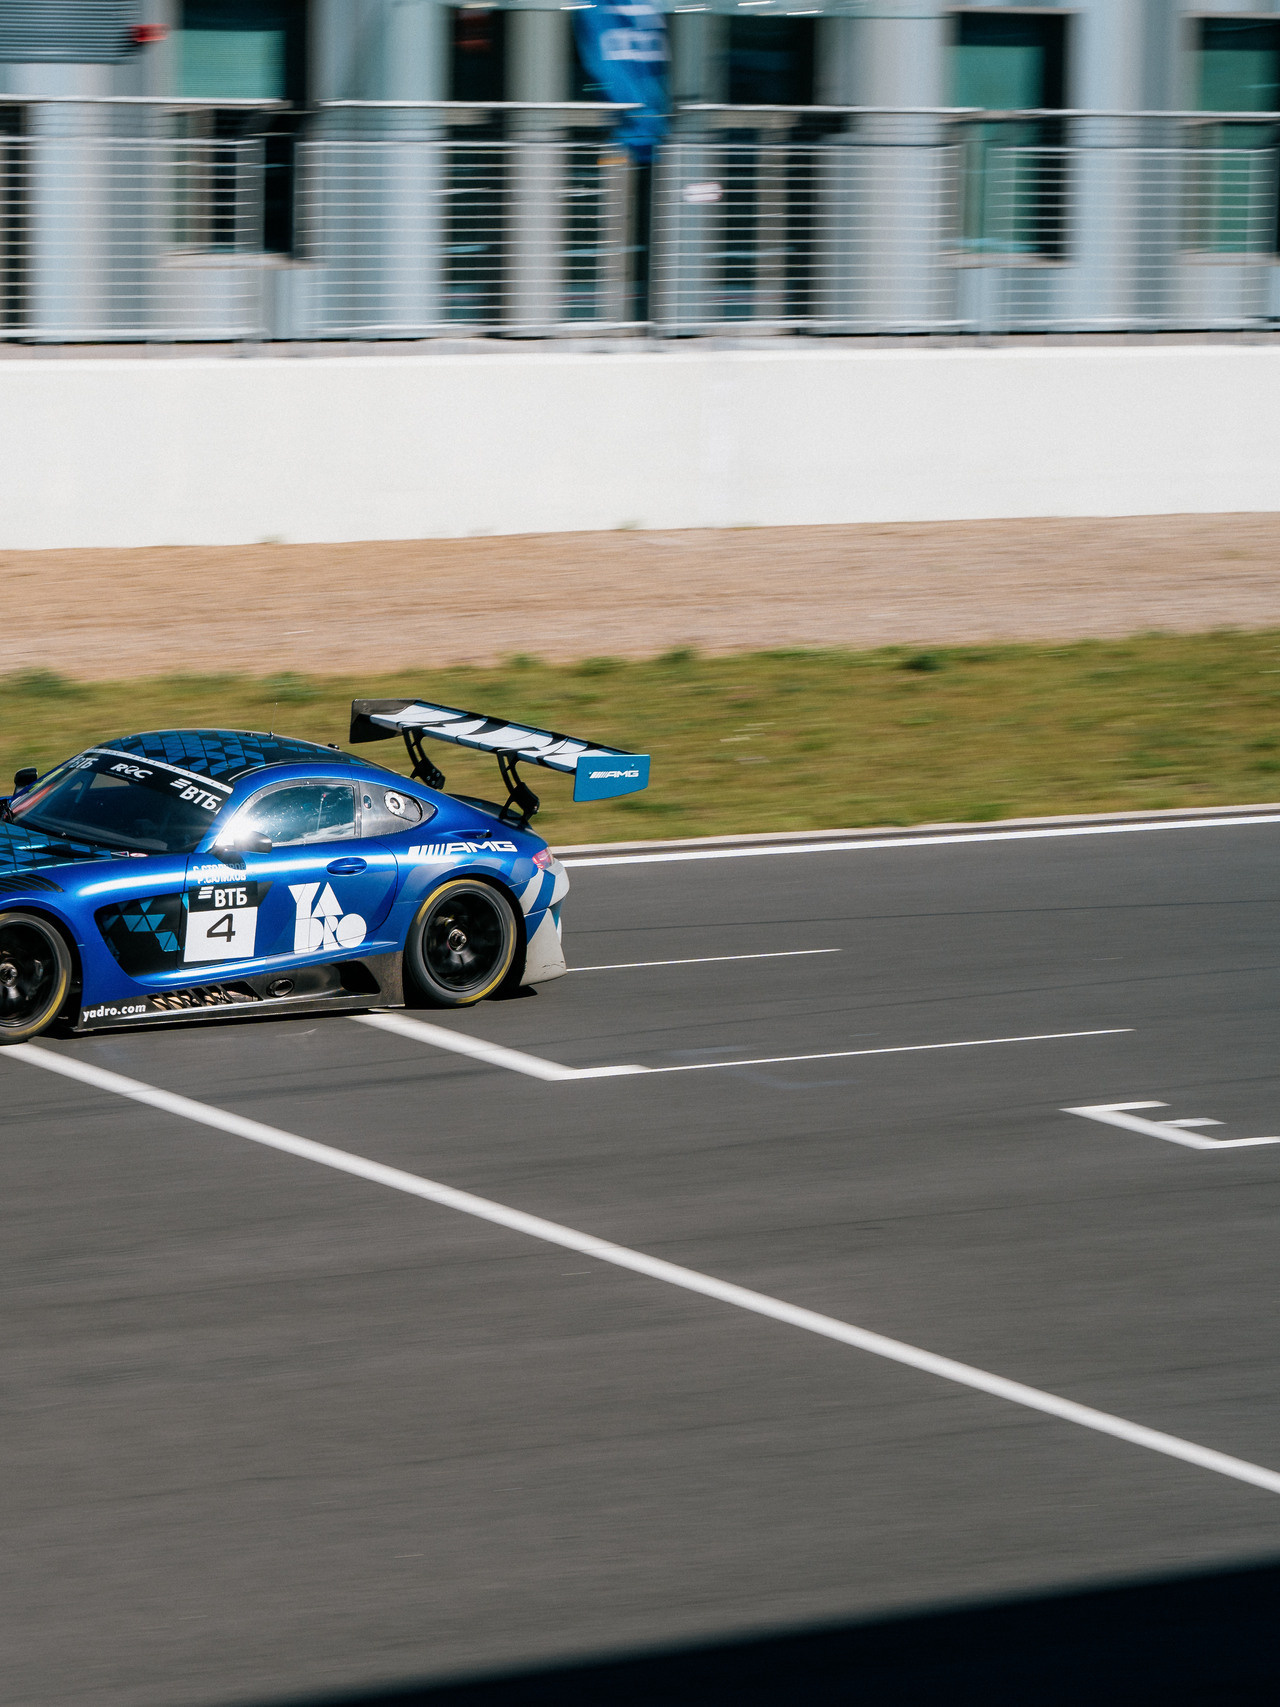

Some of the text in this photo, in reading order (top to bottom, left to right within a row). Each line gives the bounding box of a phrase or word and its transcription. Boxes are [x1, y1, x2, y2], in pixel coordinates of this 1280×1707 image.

[606, 770, 640, 778] AMG
[179, 785, 223, 810] ВТБ
[444, 841, 518, 856] AMG
[214, 887, 248, 908] ВТБ
[206, 913, 236, 943] 4
[83, 1004, 147, 1022] yadro.com
